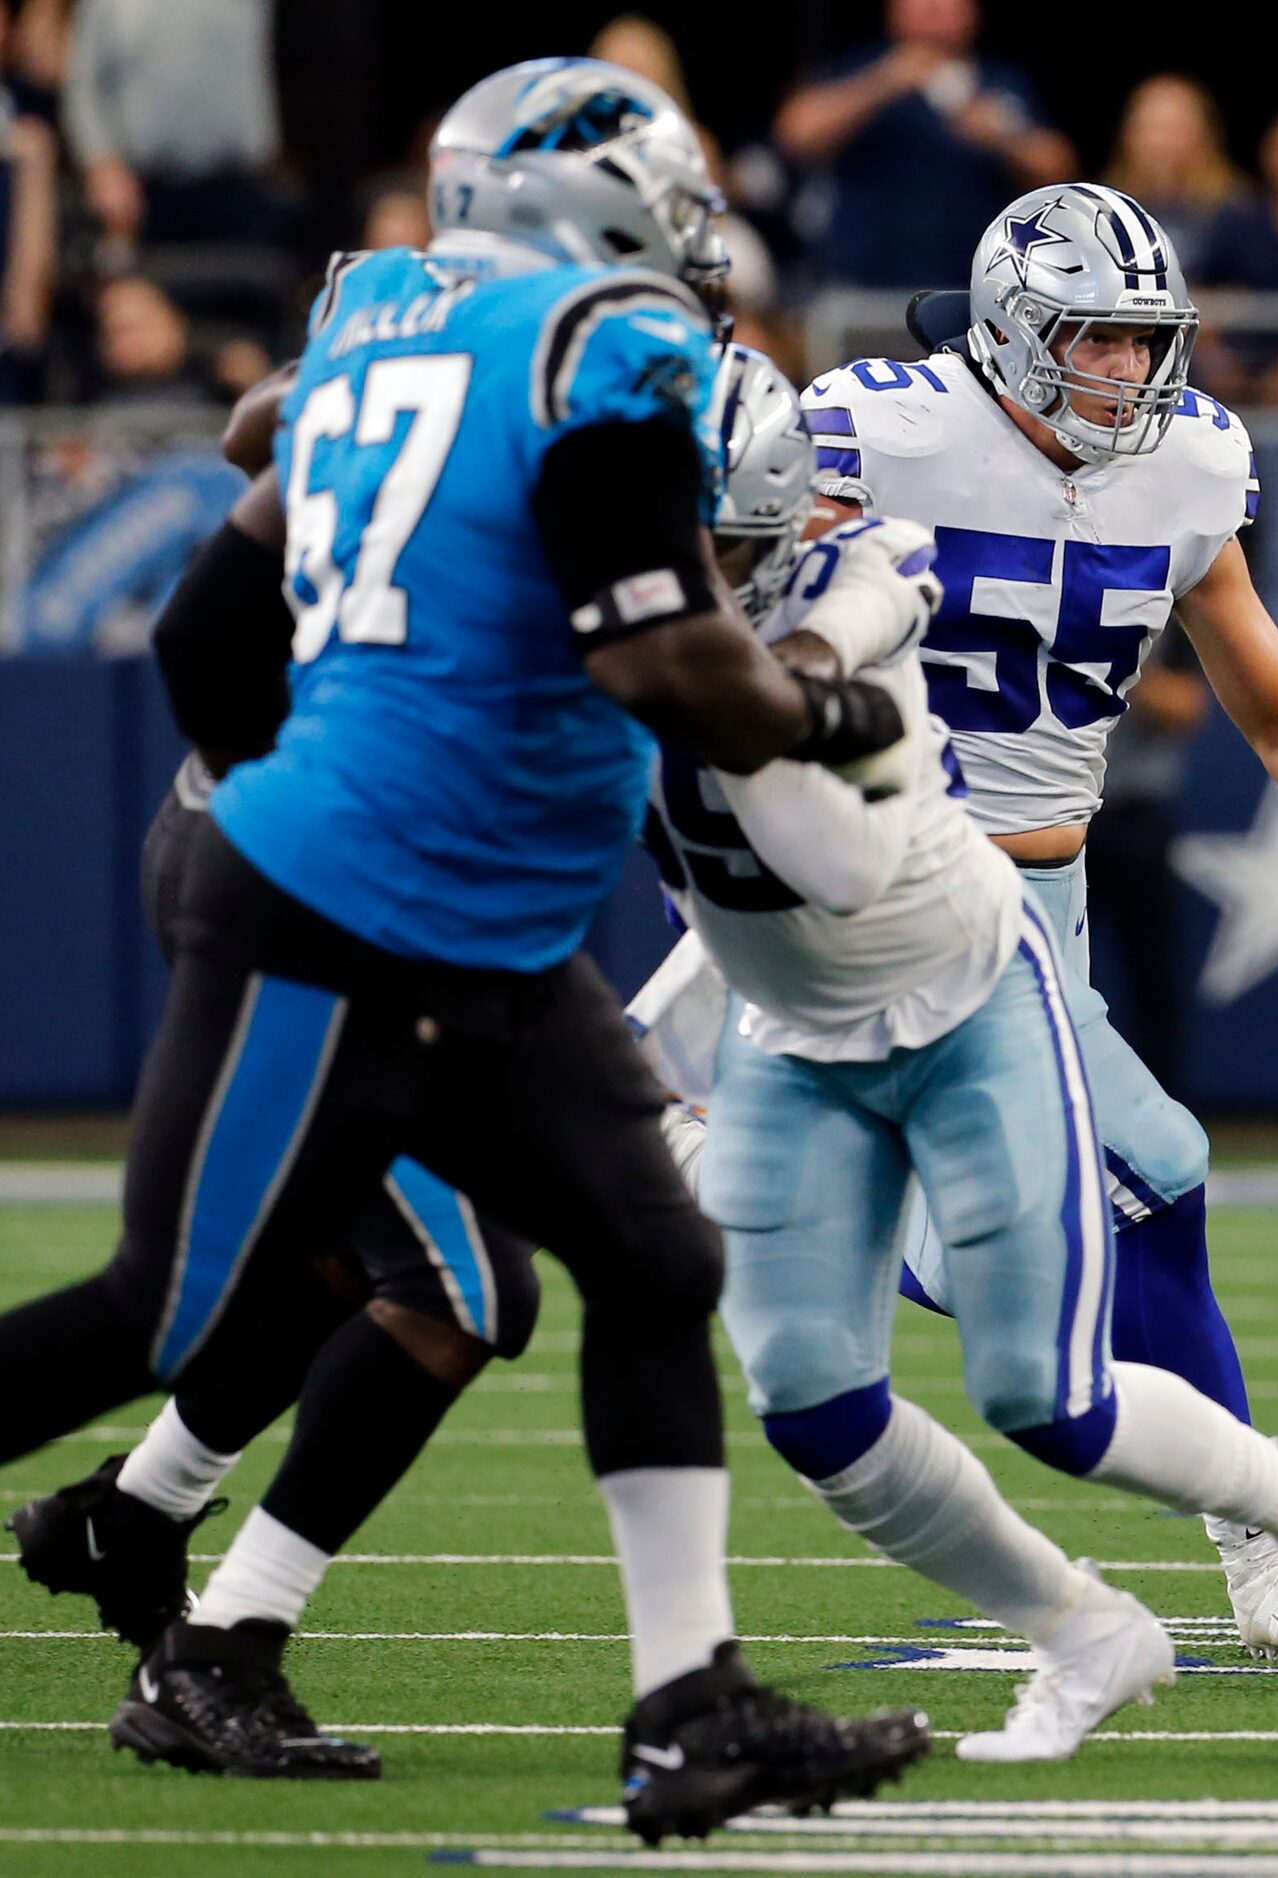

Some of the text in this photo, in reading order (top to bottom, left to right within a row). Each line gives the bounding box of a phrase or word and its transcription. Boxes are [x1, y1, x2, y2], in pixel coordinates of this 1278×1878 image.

[1132, 297, 1166, 306] COWBOYS
[281, 352, 473, 665] 67
[918, 526, 1171, 734] 55
